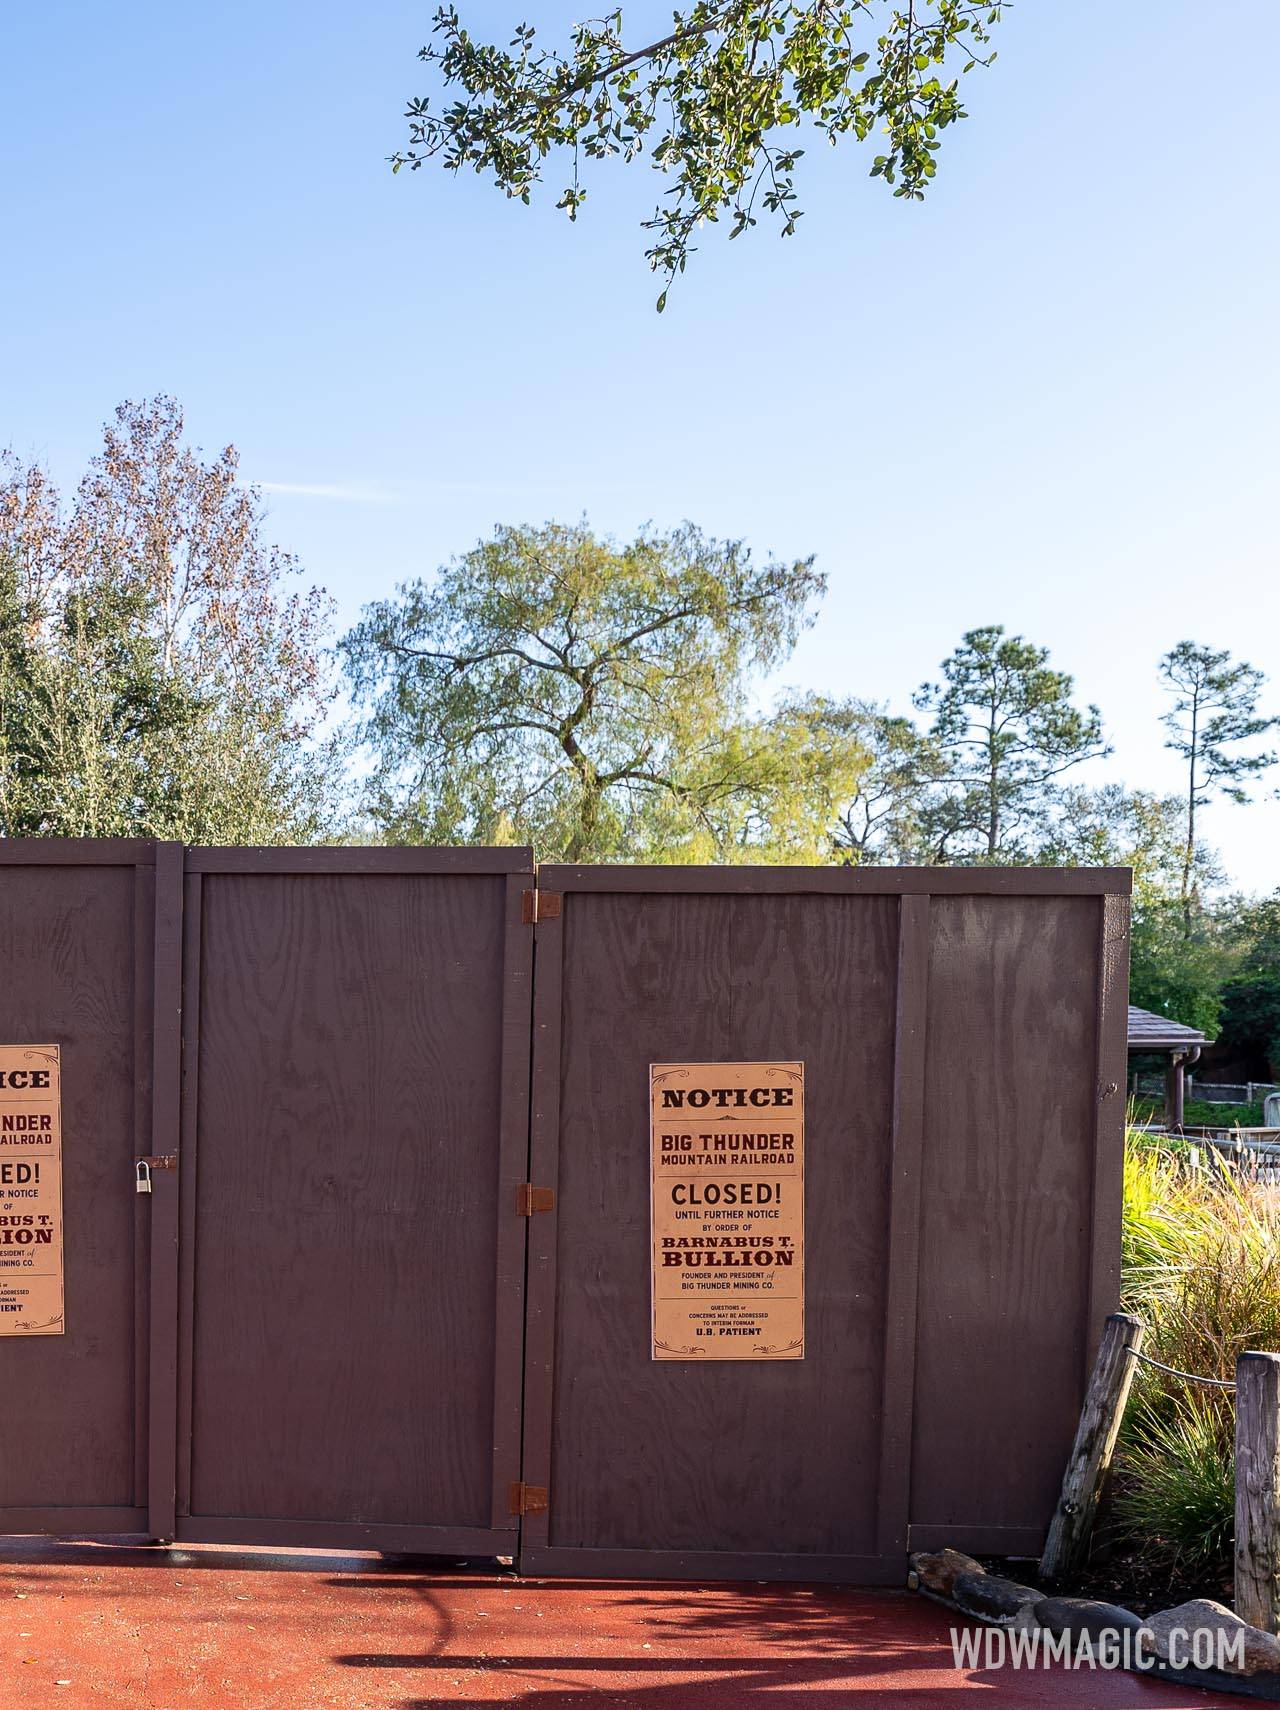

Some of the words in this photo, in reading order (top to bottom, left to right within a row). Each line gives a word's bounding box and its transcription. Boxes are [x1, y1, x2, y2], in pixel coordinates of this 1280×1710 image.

[662, 1088, 793, 1107] NOTICE
[662, 1135, 692, 1151] BIG
[699, 1134, 794, 1151] THUNDER
[662, 1154, 726, 1165] MOUNTAIN
[731, 1153, 794, 1164] RAILROAD
[8, 1189, 38, 1197] NOTICE
[672, 1183, 780, 1205] CLOSED!
[676, 1211, 701, 1219] UNTIL
[704, 1211, 743, 1219] FURTHER
[747, 1210, 779, 1218] NOTICE
[38, 1215, 53, 1226] T.
[662, 1237, 774, 1248] BARNABUS
[779, 1237, 794, 1248] T.
[26, 1248, 35, 1258] of
[662, 1251, 794, 1267] BULLION
[766, 1270, 774, 1280] of
[682, 1282, 694, 1290] BIG
[696, 1282, 730, 1290] THUNDER
[696, 1328, 715, 1336] U.B.
